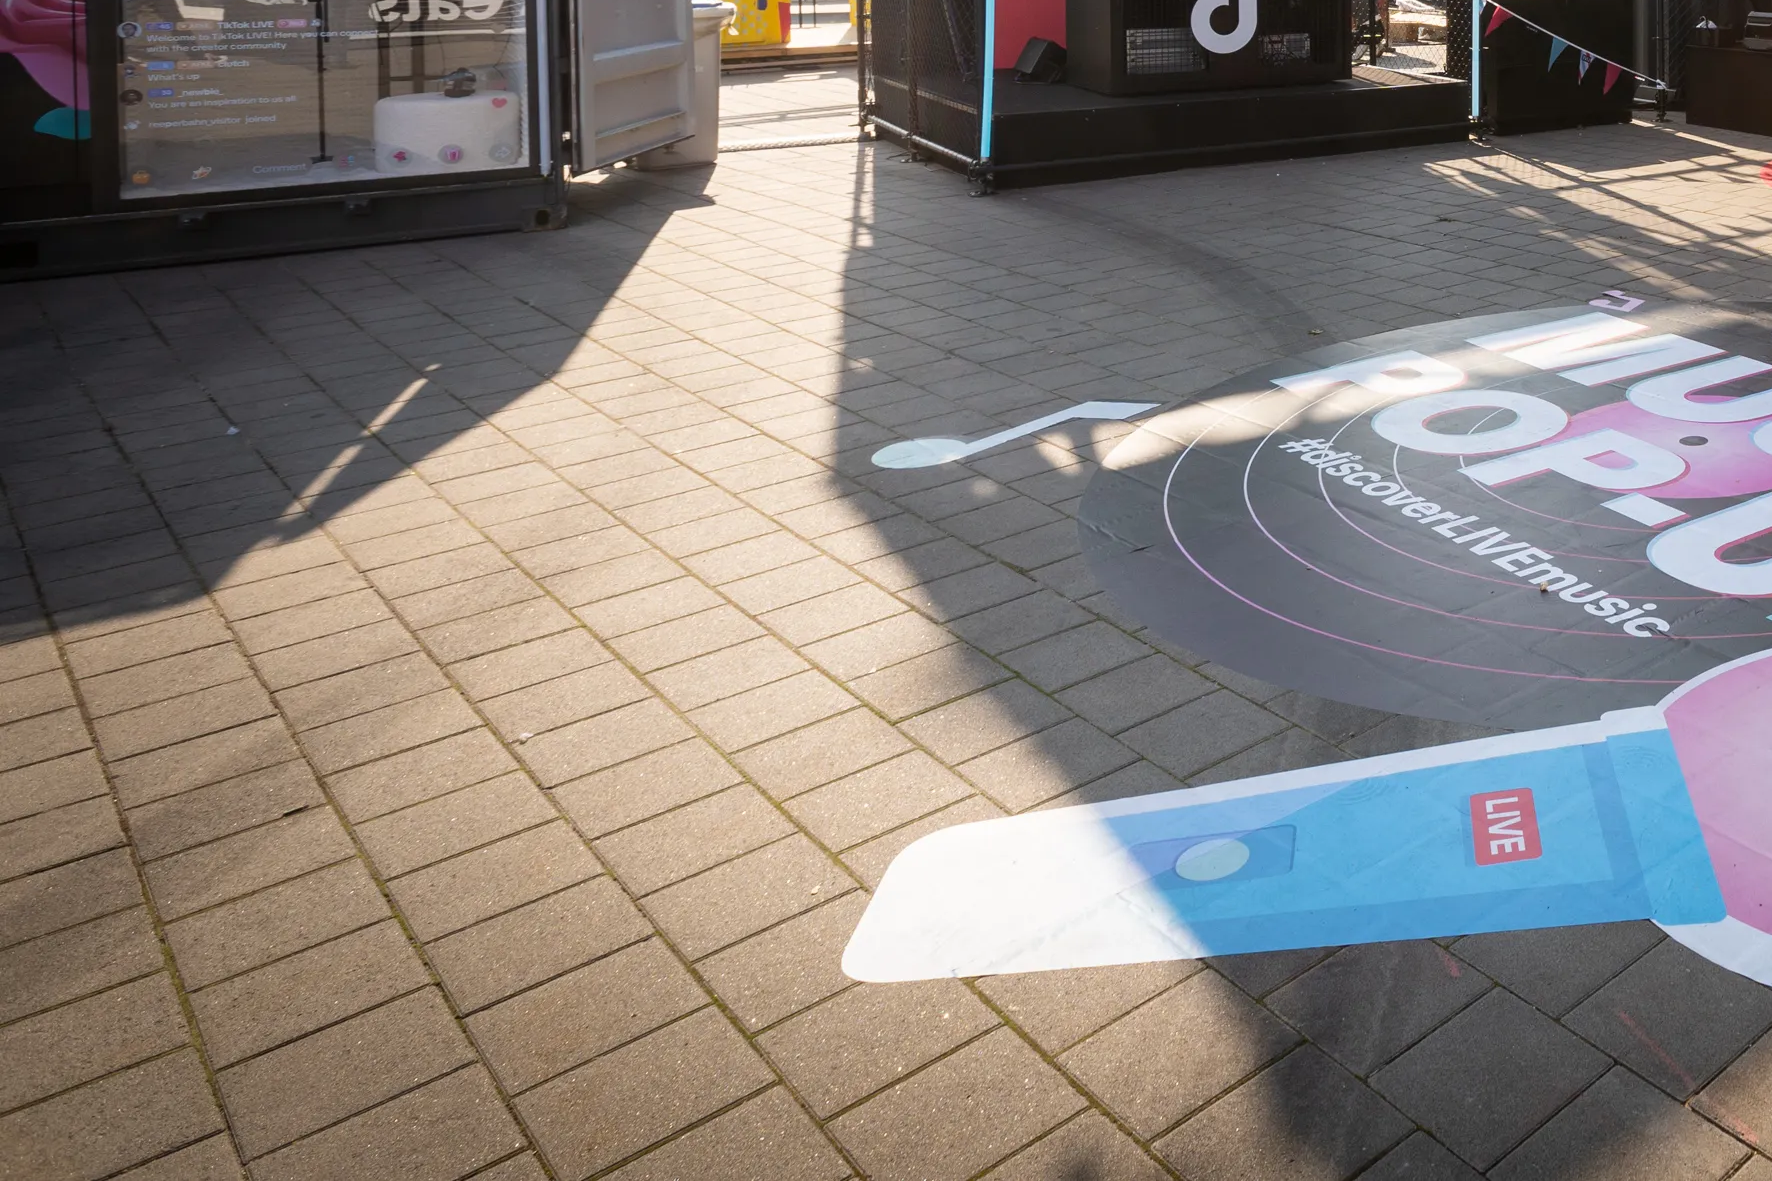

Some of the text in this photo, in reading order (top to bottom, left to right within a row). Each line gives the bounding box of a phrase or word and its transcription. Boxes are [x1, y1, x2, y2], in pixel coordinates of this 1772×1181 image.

[252, 20, 275, 28] LIVE
[147, 34, 196, 42] Welcome
[198, 33, 211, 41] to
[212, 32, 244, 41] TikTok
[246, 31, 272, 39] LIVE!
[301, 31, 318, 39] you
[320, 30, 338, 38] can
[340, 29, 379, 37] connect
[172, 44, 189, 52] the
[191, 43, 229, 51] creator
[230, 42, 287, 50] community
[148, 73, 201, 82] What's up
[149, 101, 168, 109] You
[204, 96, 258, 106] inspiration
[149, 114, 276, 129] reeperbahn_visitor joined
[252, 163, 307, 174] Comment
[1277, 437, 1671, 639] #discoverLIVEmusic
[1485, 796, 1526, 856] LIVE
